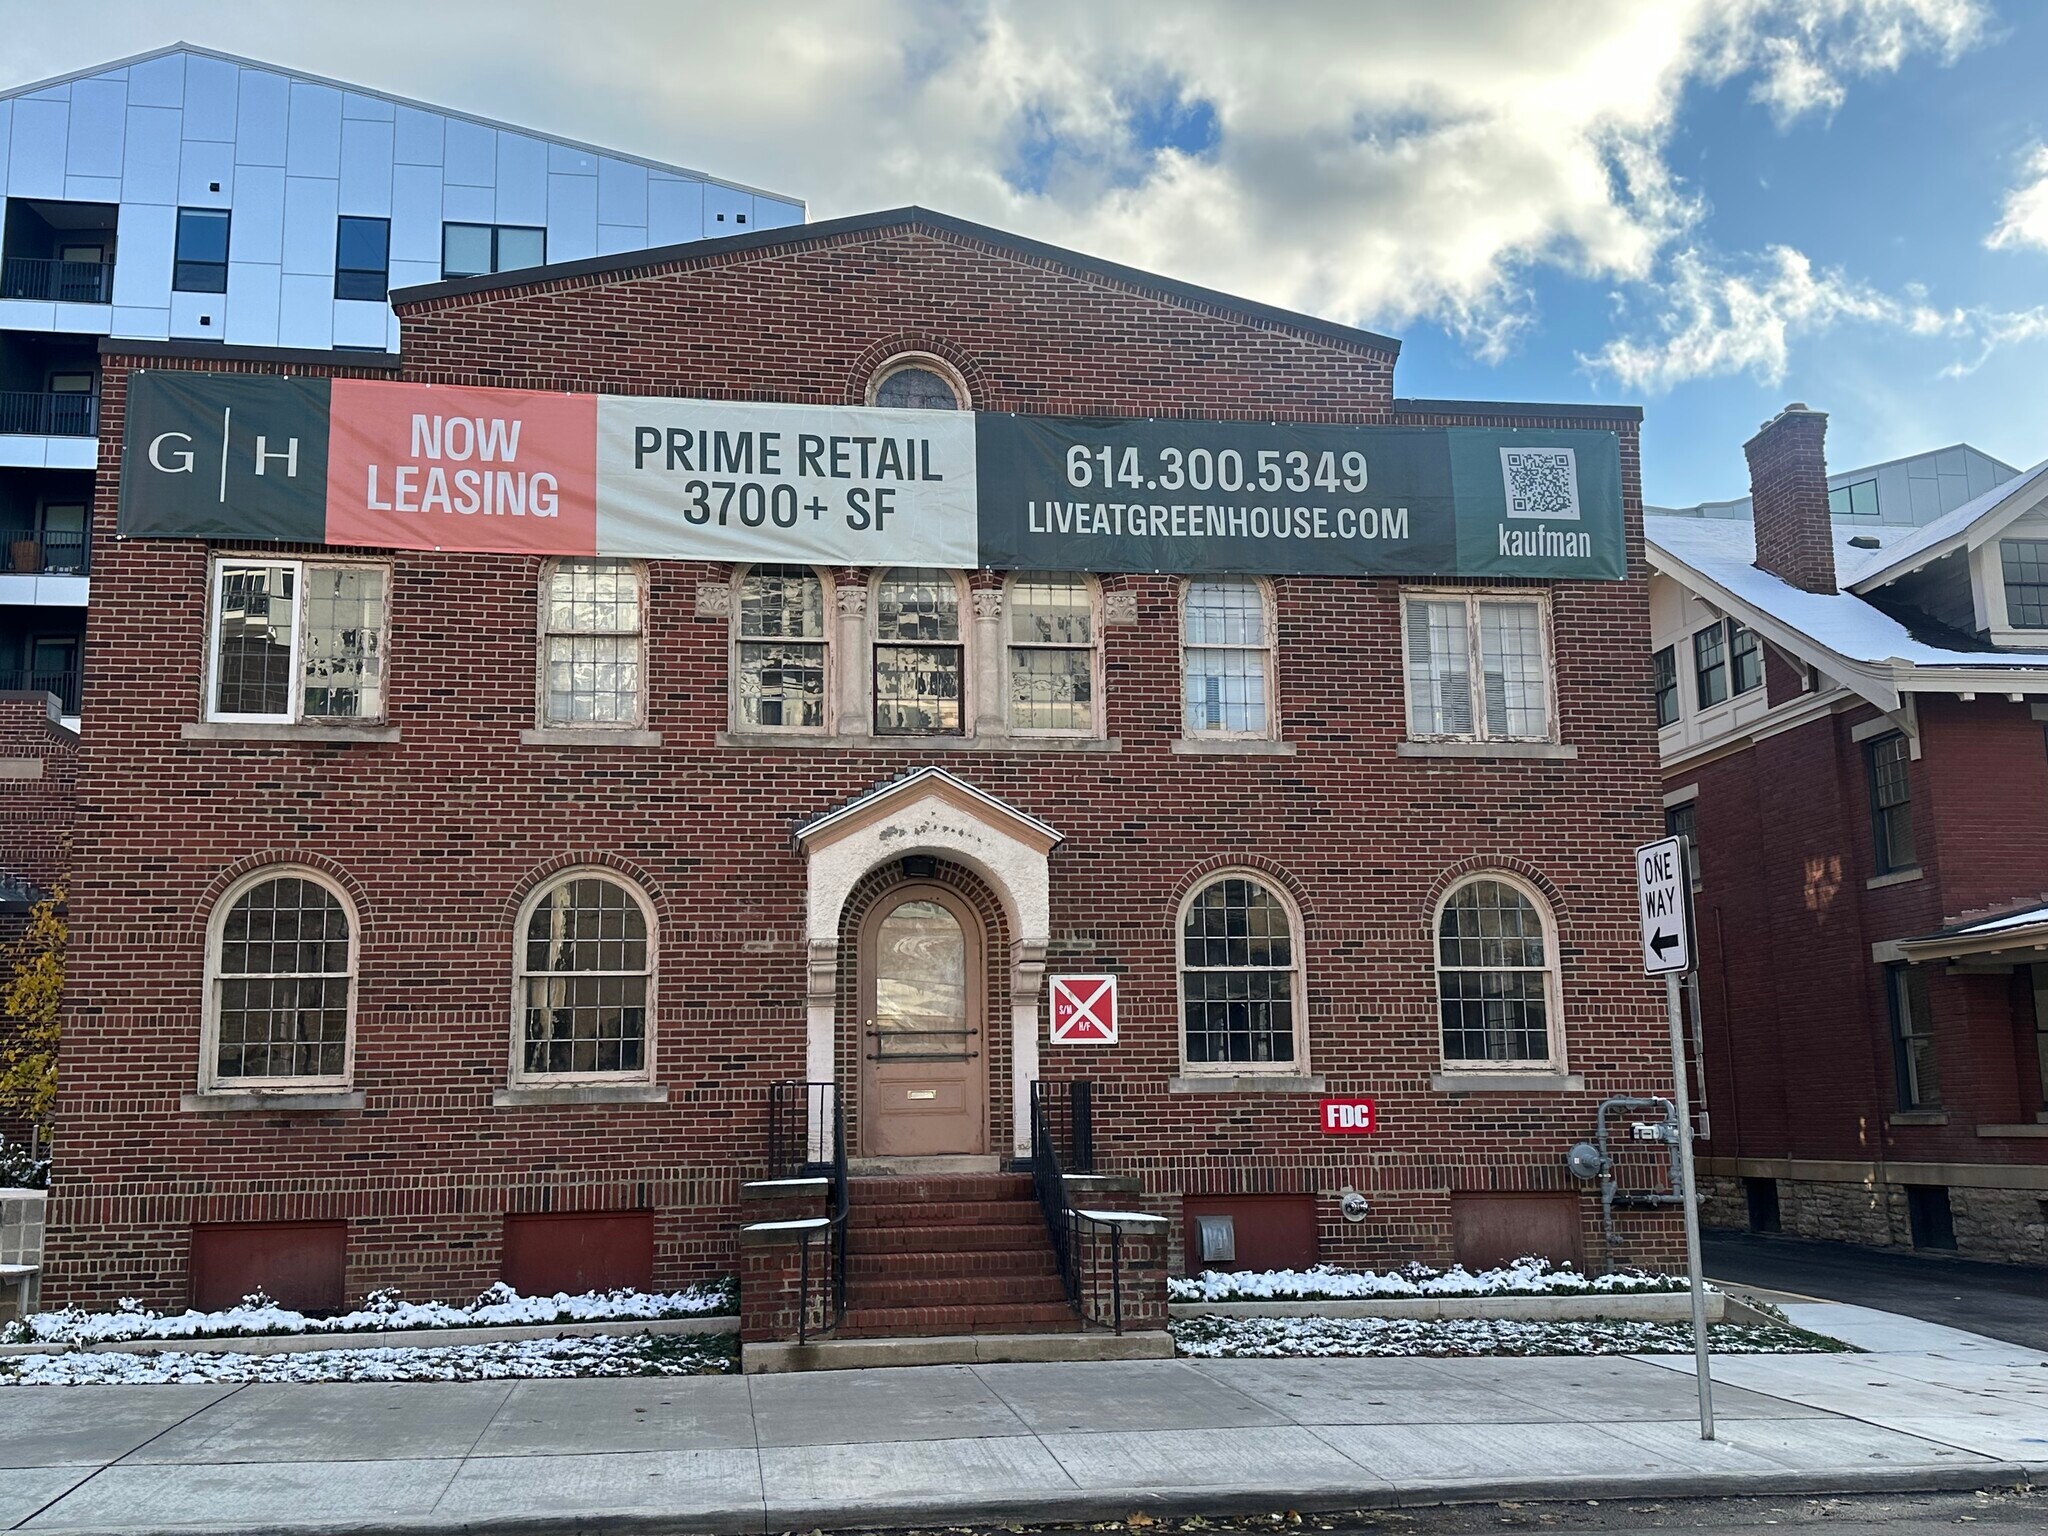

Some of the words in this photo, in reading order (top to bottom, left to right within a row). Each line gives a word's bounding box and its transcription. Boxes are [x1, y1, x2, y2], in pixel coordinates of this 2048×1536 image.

[148, 432, 194, 474] G
[255, 436, 298, 477] H
[410, 414, 522, 463] NOW
[634, 425, 782, 477] PRIME
[797, 432, 943, 483] RETAIL
[367, 464, 559, 519] LEASING
[1066, 444, 1369, 494] 614.300.5349
[683, 480, 829, 529] 3700+
[845, 486, 897, 532] SF
[1028, 501, 1409, 539] LIVEATGREENHOUSE.COM
[1499, 523, 1591, 558] kaufman
[1644, 852, 1673, 885] ONE
[1645, 886, 1675, 919] WAY
[1327, 1104, 1370, 1128] FDC
